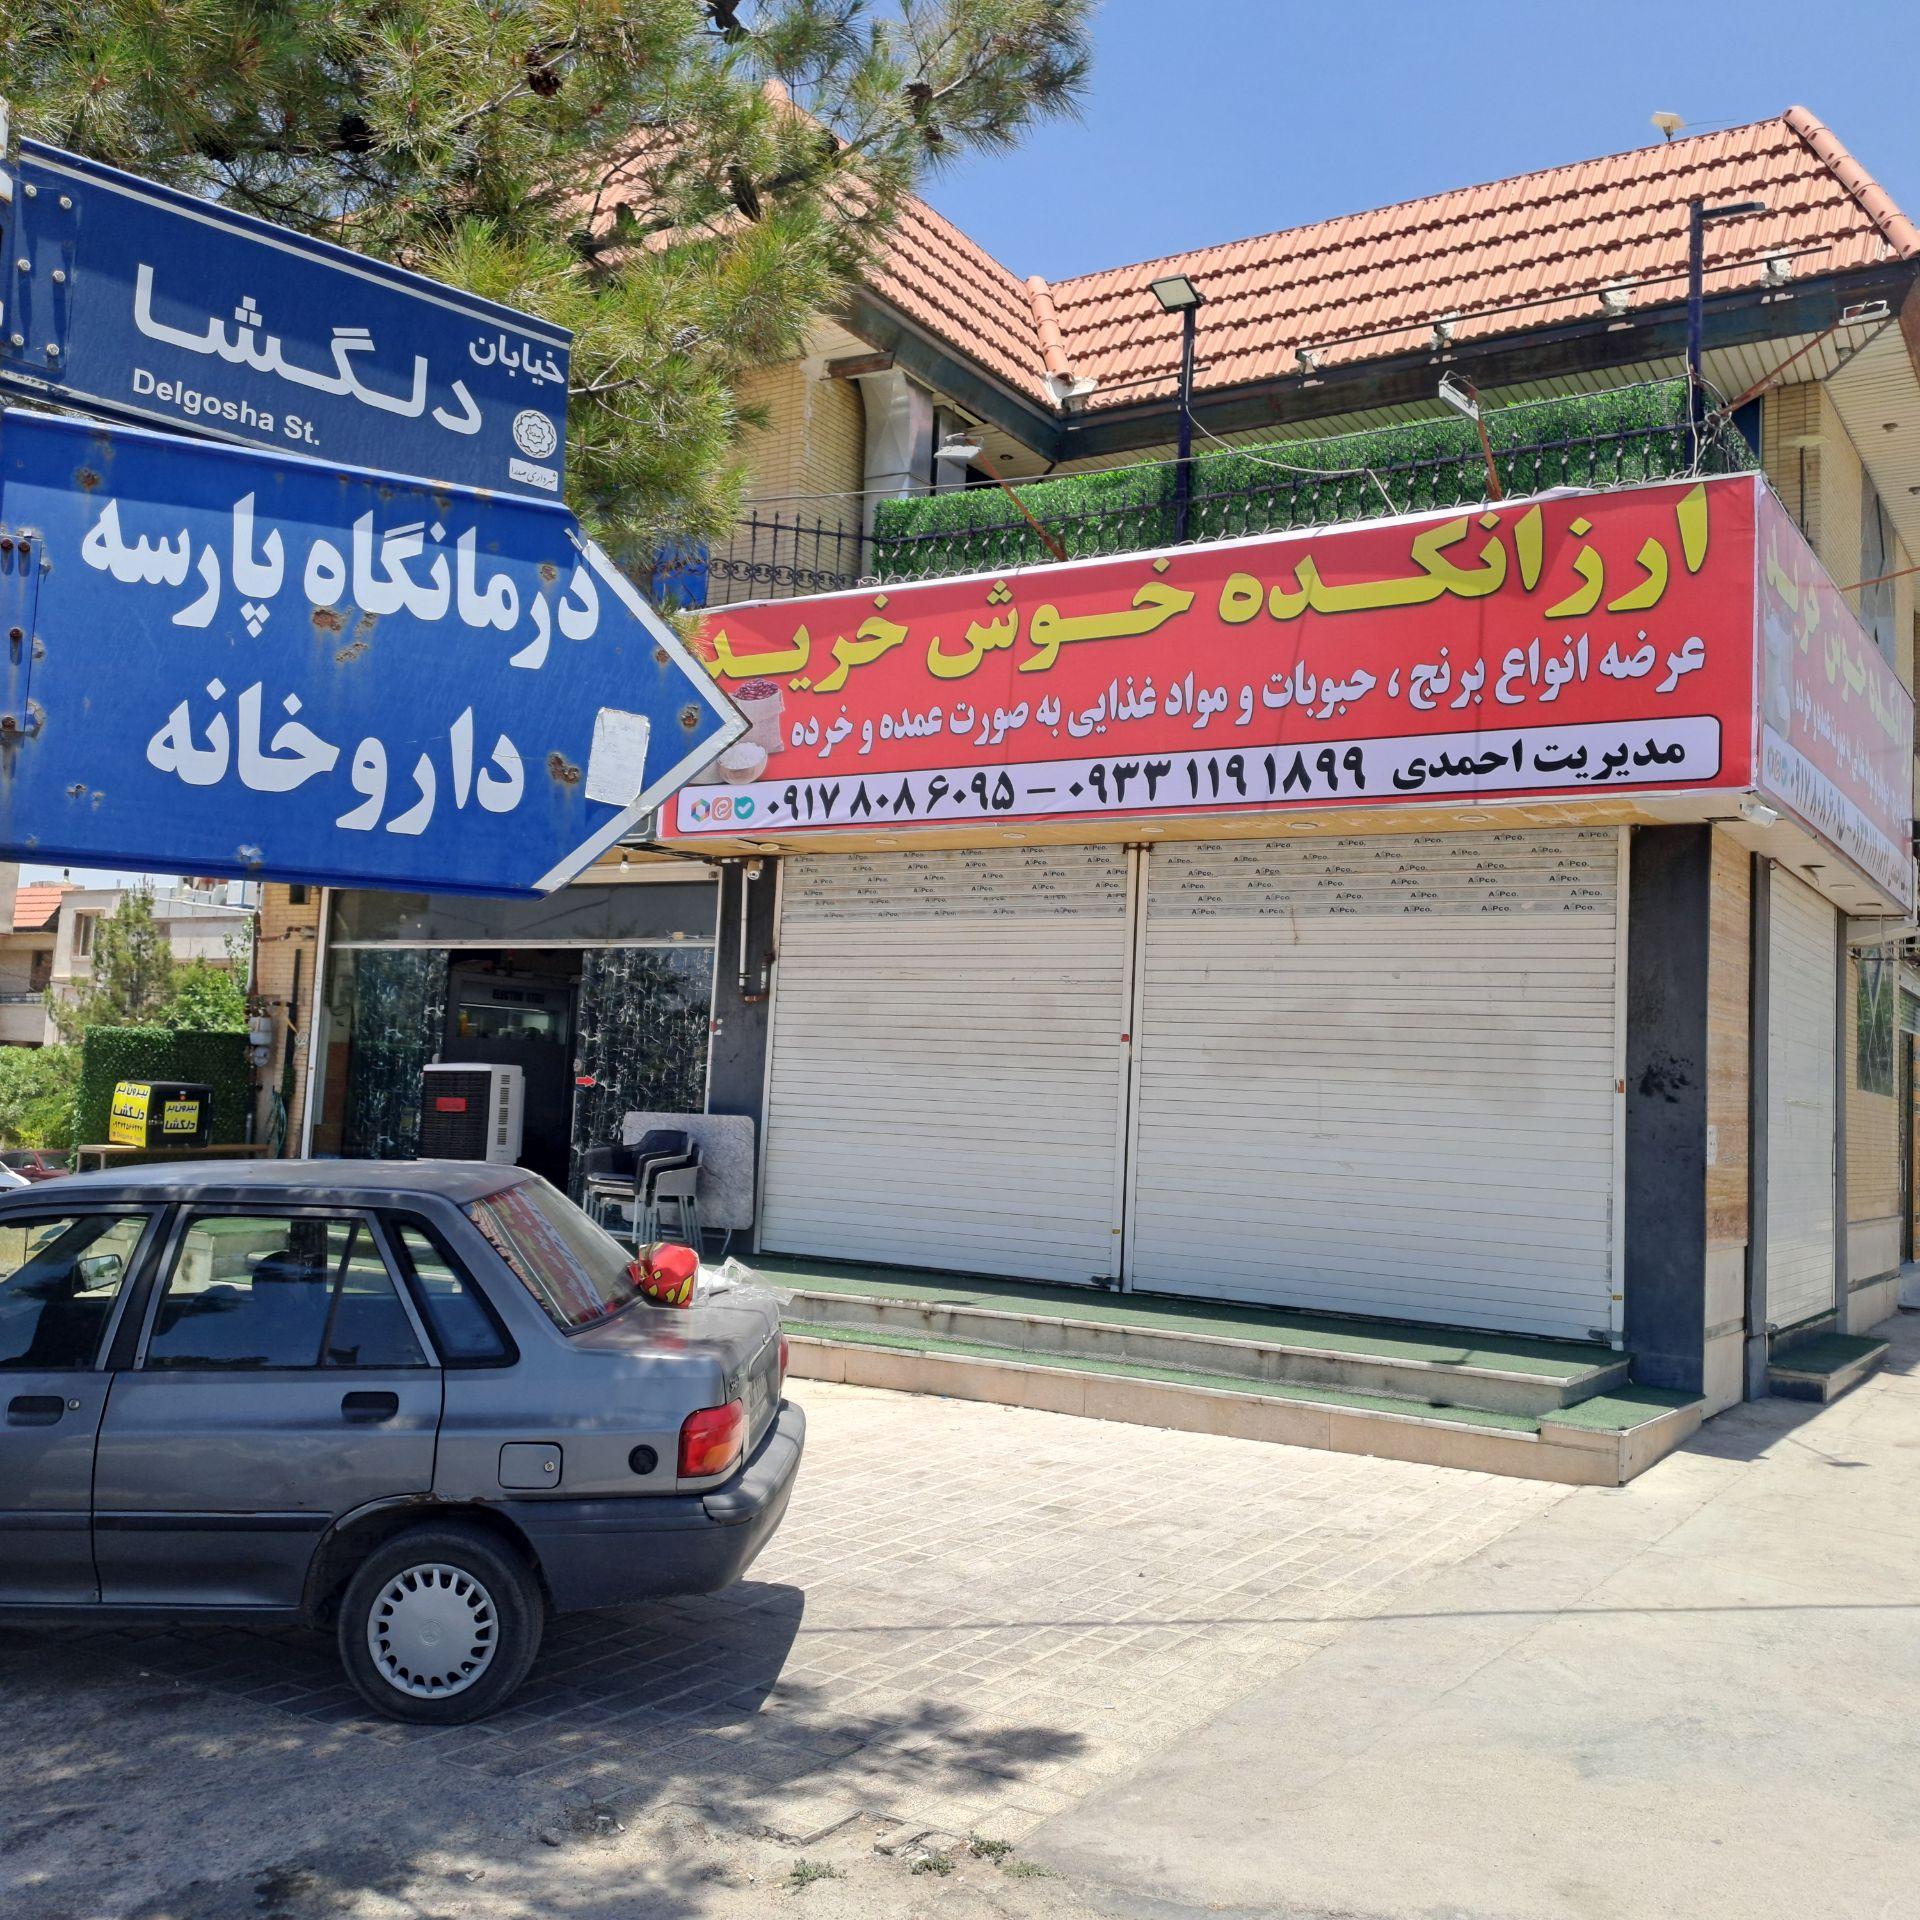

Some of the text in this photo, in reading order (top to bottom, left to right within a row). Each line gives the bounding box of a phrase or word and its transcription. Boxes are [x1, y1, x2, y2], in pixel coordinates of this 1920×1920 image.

[134, 263, 481, 436] دلگشا
[468, 331, 565, 386] خیابان
[132, 368, 320, 447] Delgosha St.
[80, 491, 600, 671] درمانگاه پارسه
[701, 483, 1708, 693] ارزانکده خوش خرید
[1262, 661, 1378, 719] حبوبات
[1495, 633, 1589, 705] انواع
[1599, 630, 1706, 693] عرضه
[879, 706, 943, 741] عمده
[949, 699, 1029, 746] صورت
[1036, 694, 1061, 738] به
[1067, 676, 1157, 738] غذایی
[1163, 671, 1228, 729] مواد
[1235, 684, 1254, 727] و
[146, 677, 525, 834] داروخانه
[790, 704, 854, 758] خرده
[858, 720, 873, 755] و
[1393, 737, 1686, 791] مدیریت احمدی
